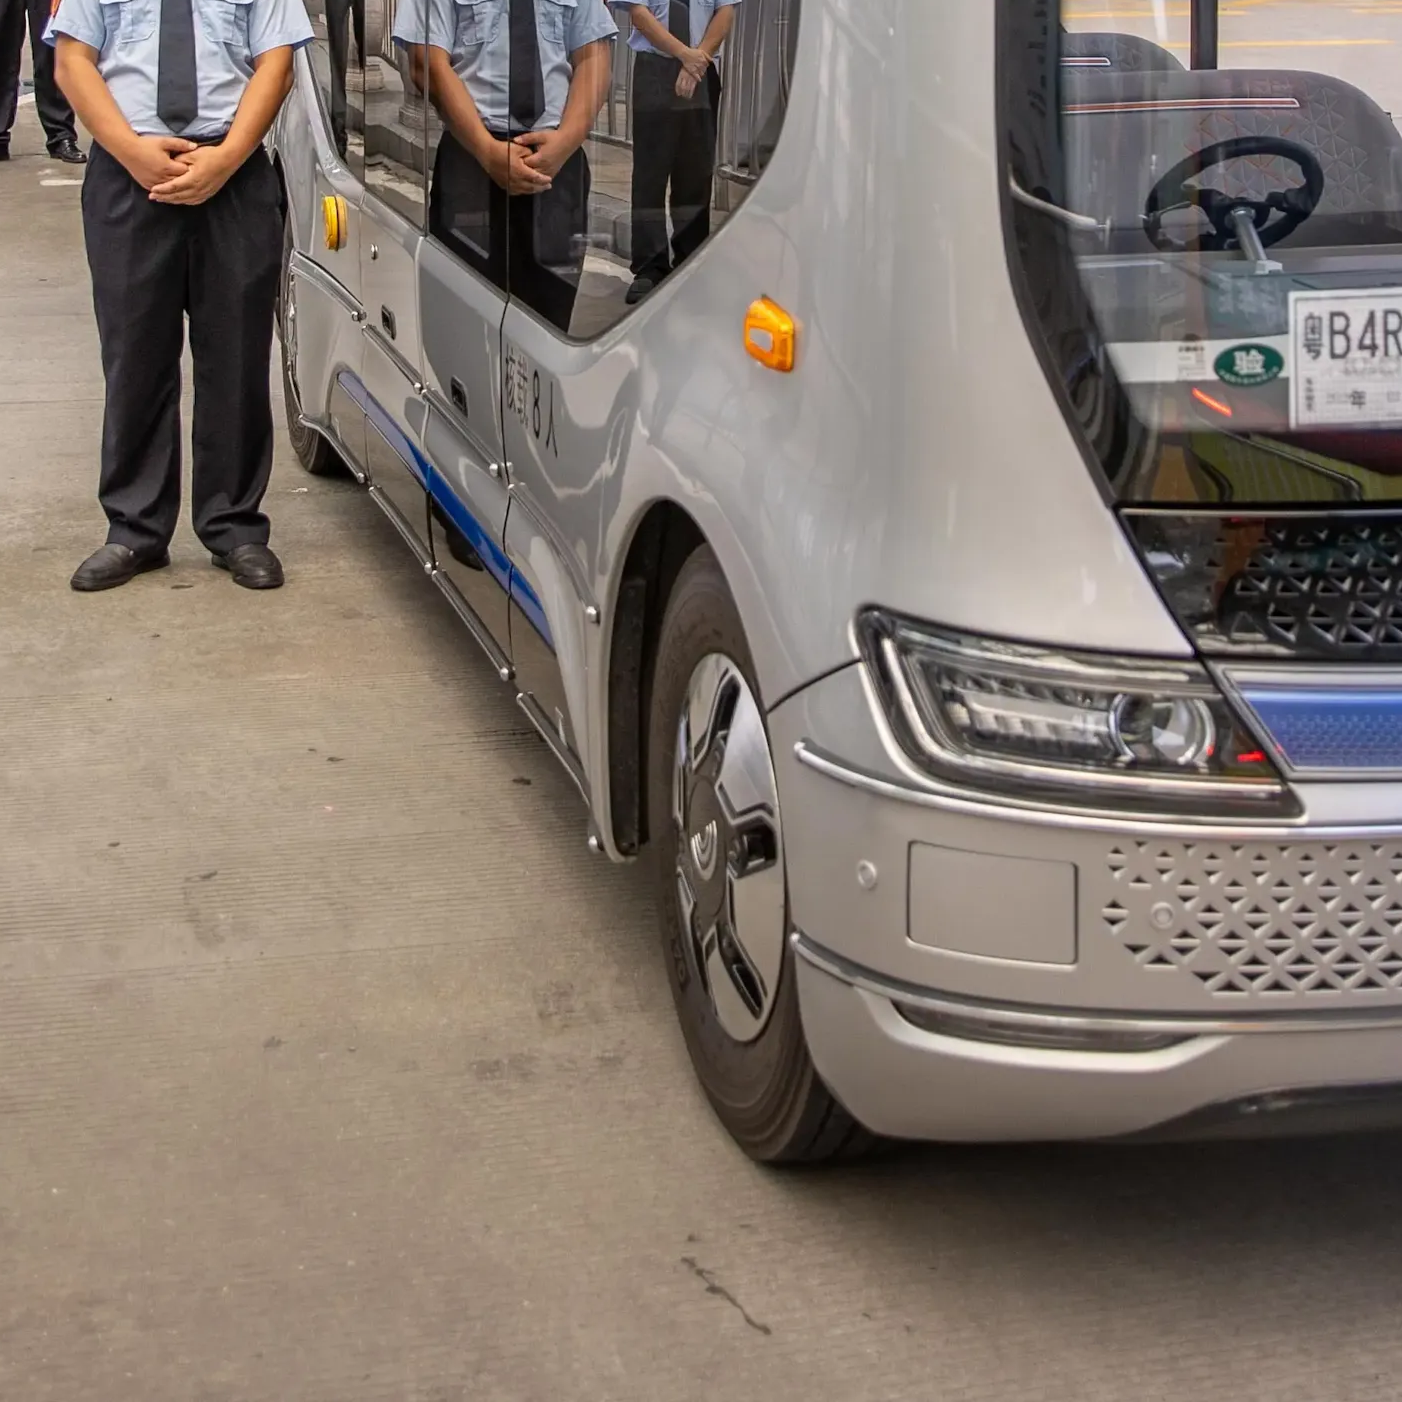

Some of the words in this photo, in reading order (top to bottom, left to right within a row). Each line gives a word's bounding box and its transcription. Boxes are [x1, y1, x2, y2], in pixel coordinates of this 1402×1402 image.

[1233, 348, 1265, 376] 验
[504, 341, 558, 459] 核载8人
